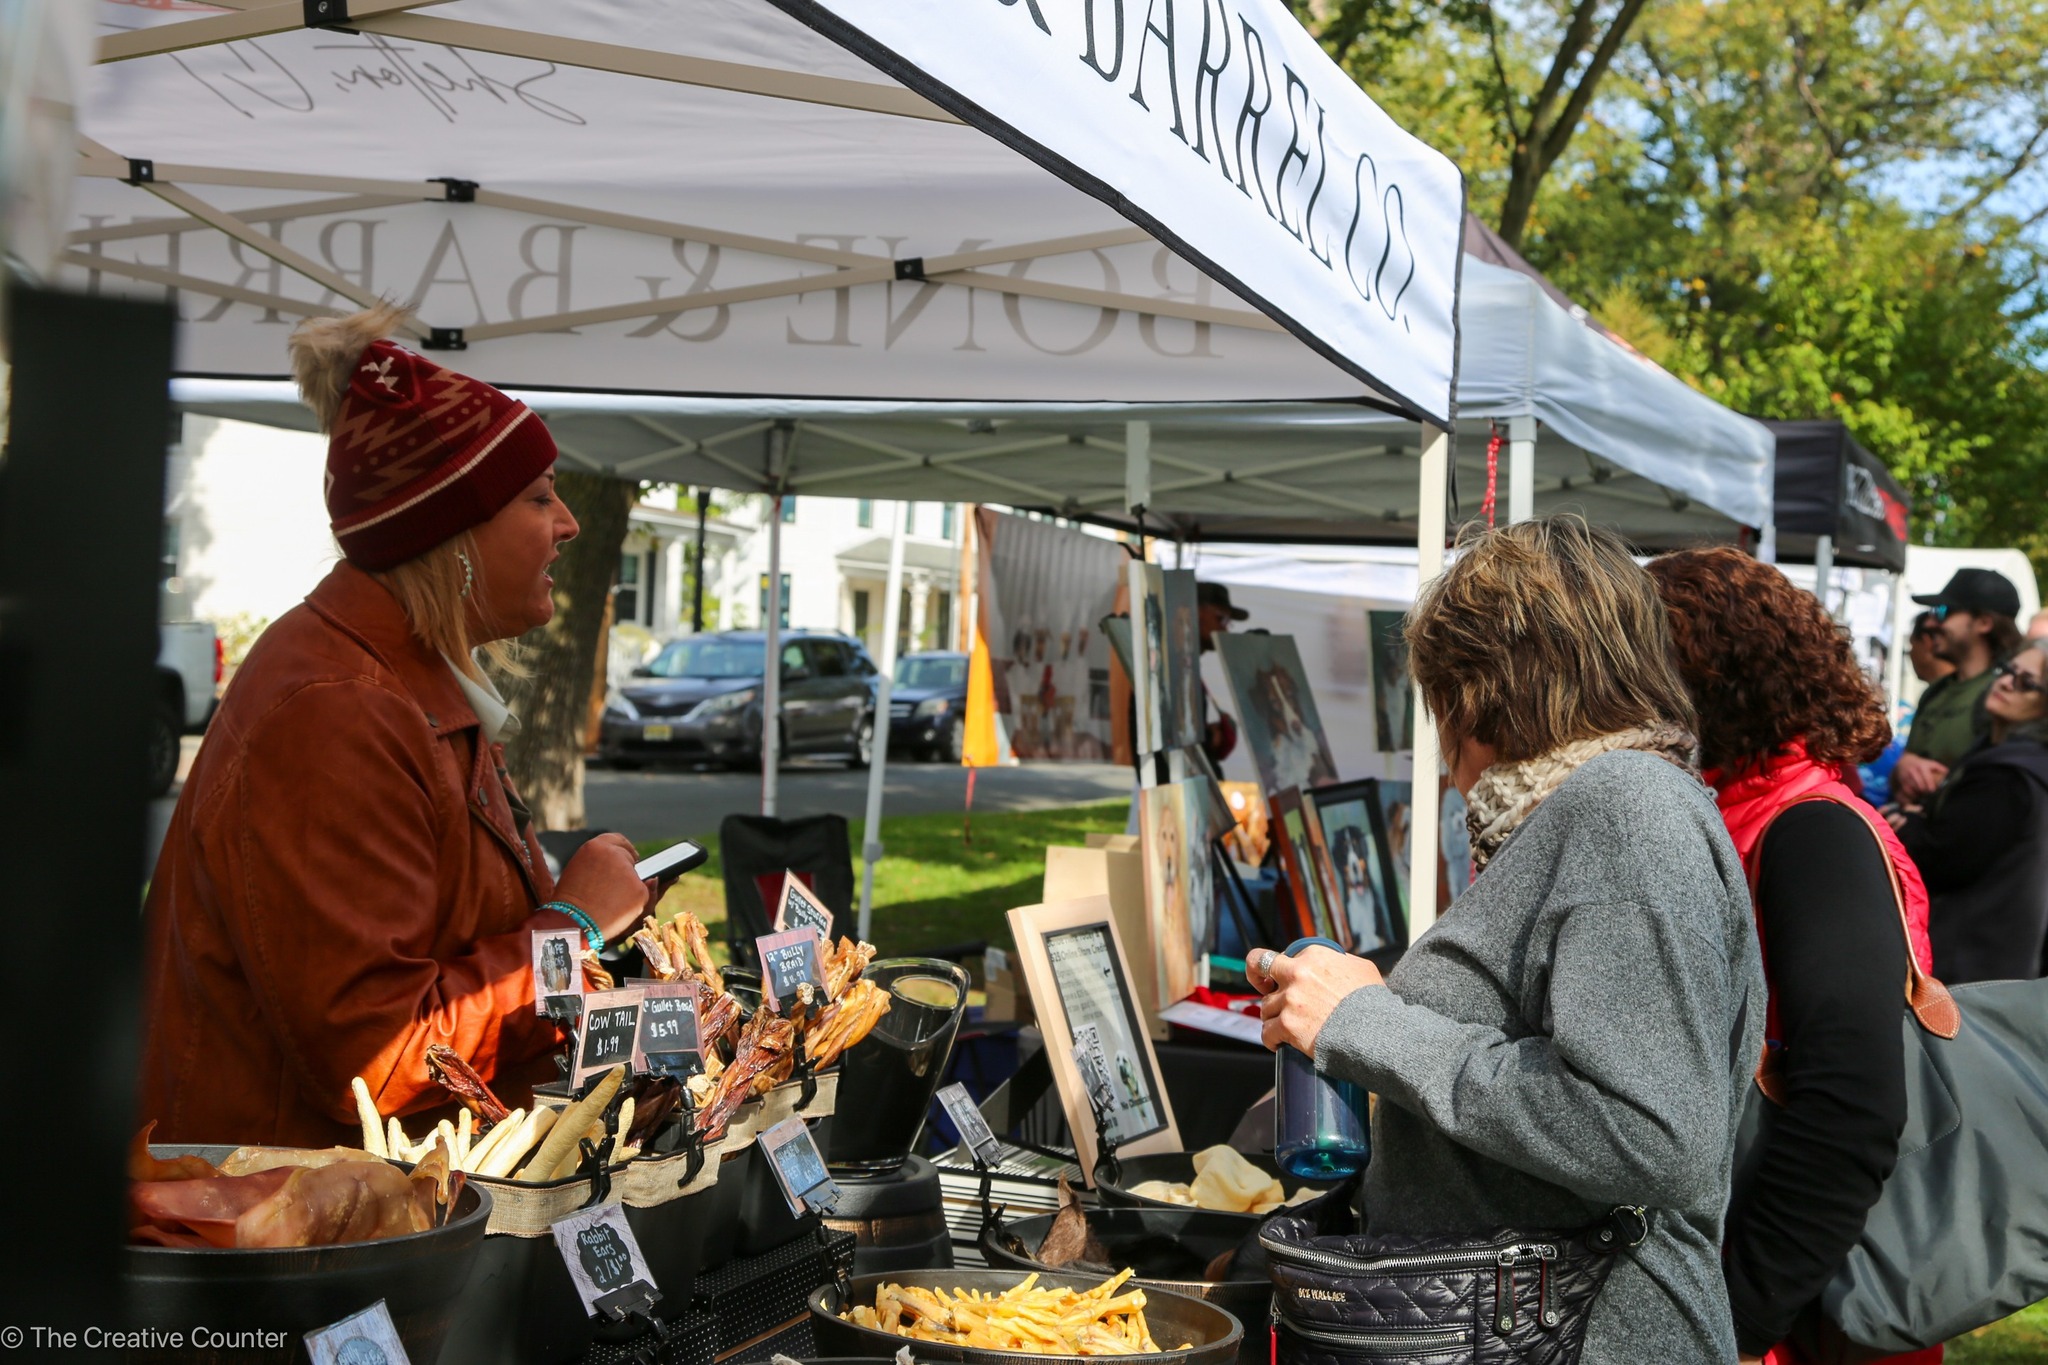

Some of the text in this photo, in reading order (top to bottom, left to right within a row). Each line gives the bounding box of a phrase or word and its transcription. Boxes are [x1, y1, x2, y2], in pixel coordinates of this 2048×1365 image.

[1345, 153, 1410, 334] CO.
[779, 957, 804, 973] BRAID
[651, 999, 673, 1014] Gullet
[614, 1009, 636, 1027] TAIL
[650, 1018, 679, 1038] $5.99
[595, 1034, 620, 1057] $1.99
[580, 1227, 611, 1247] Rabbit
[592, 1242, 617, 1258] Ears
[1310, 1288, 1347, 1303] WALLACE
